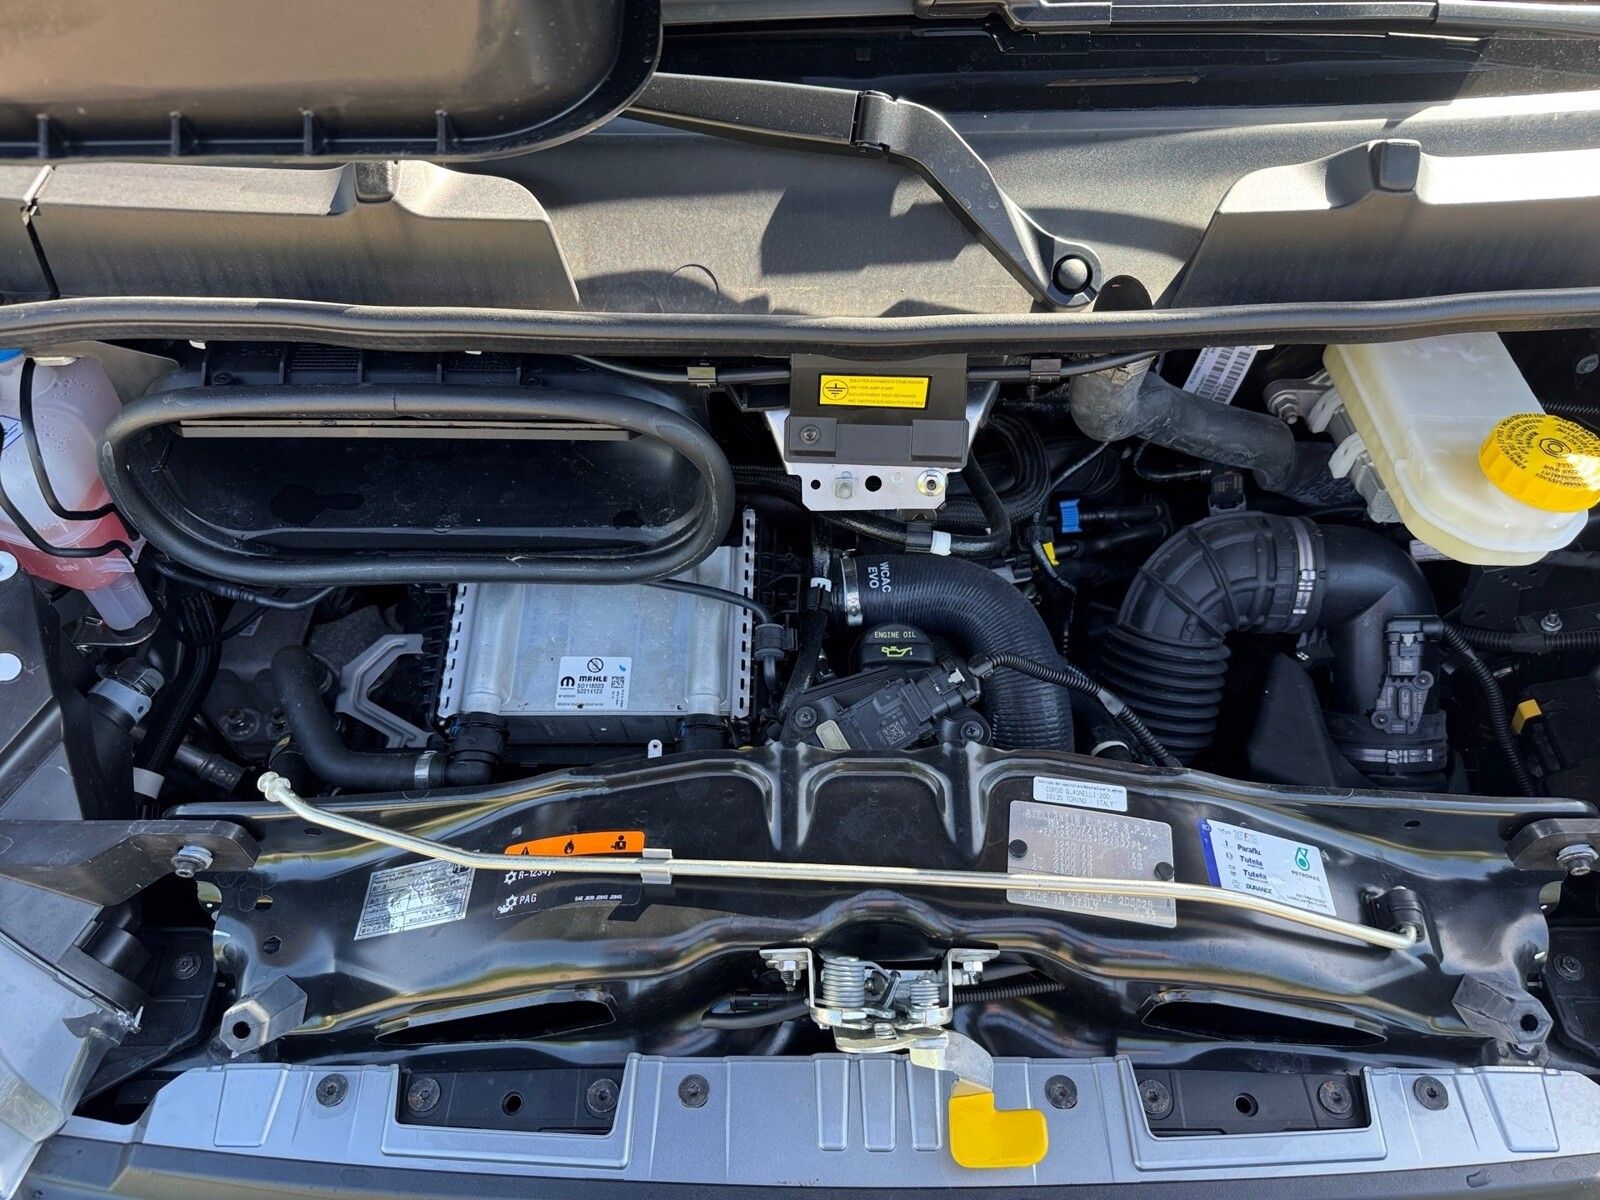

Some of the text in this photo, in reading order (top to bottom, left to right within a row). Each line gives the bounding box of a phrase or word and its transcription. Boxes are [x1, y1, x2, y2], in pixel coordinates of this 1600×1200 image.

[868, 566, 879, 588] EVO
[1046, 786, 1063, 794] CORSO
[1066, 795, 1087, 805] TORINO
[1097, 799, 1113, 807] ITALY
[1240, 855, 1263, 866] Tutela
[518, 870, 556, 880] R-1234y
[1243, 869, 1266, 880] Tutela
[1291, 870, 1320, 882] PETRONAS
[1245, 883, 1272, 894] DURANCE
[520, 894, 537, 904] PAG
[1071, 897, 1098, 910] ITALY
